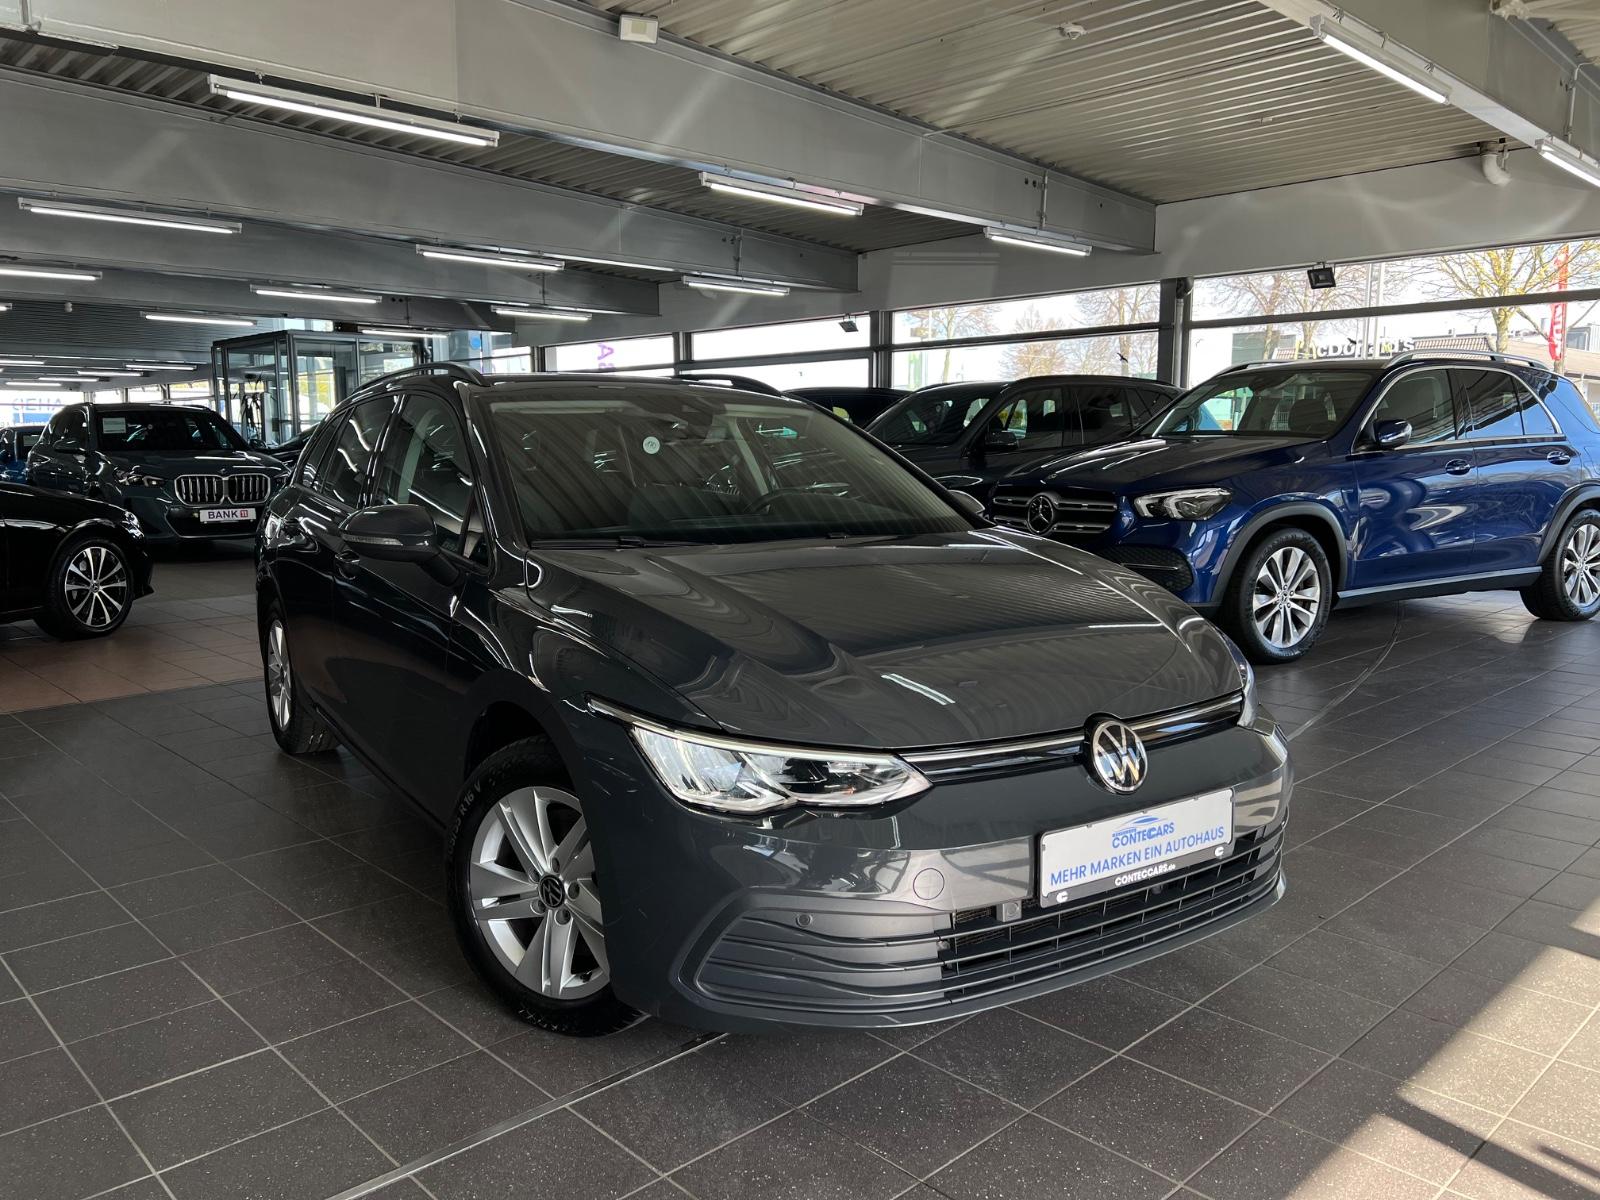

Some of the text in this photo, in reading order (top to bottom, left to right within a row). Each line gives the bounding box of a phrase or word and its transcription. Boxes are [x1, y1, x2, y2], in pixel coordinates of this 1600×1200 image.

[207, 510, 238, 519] BANK
[1050, 826, 1225, 886] MEHR MARKEN EIN AUTOHAUS
[1114, 863, 1176, 886] CONTECCARS.de
